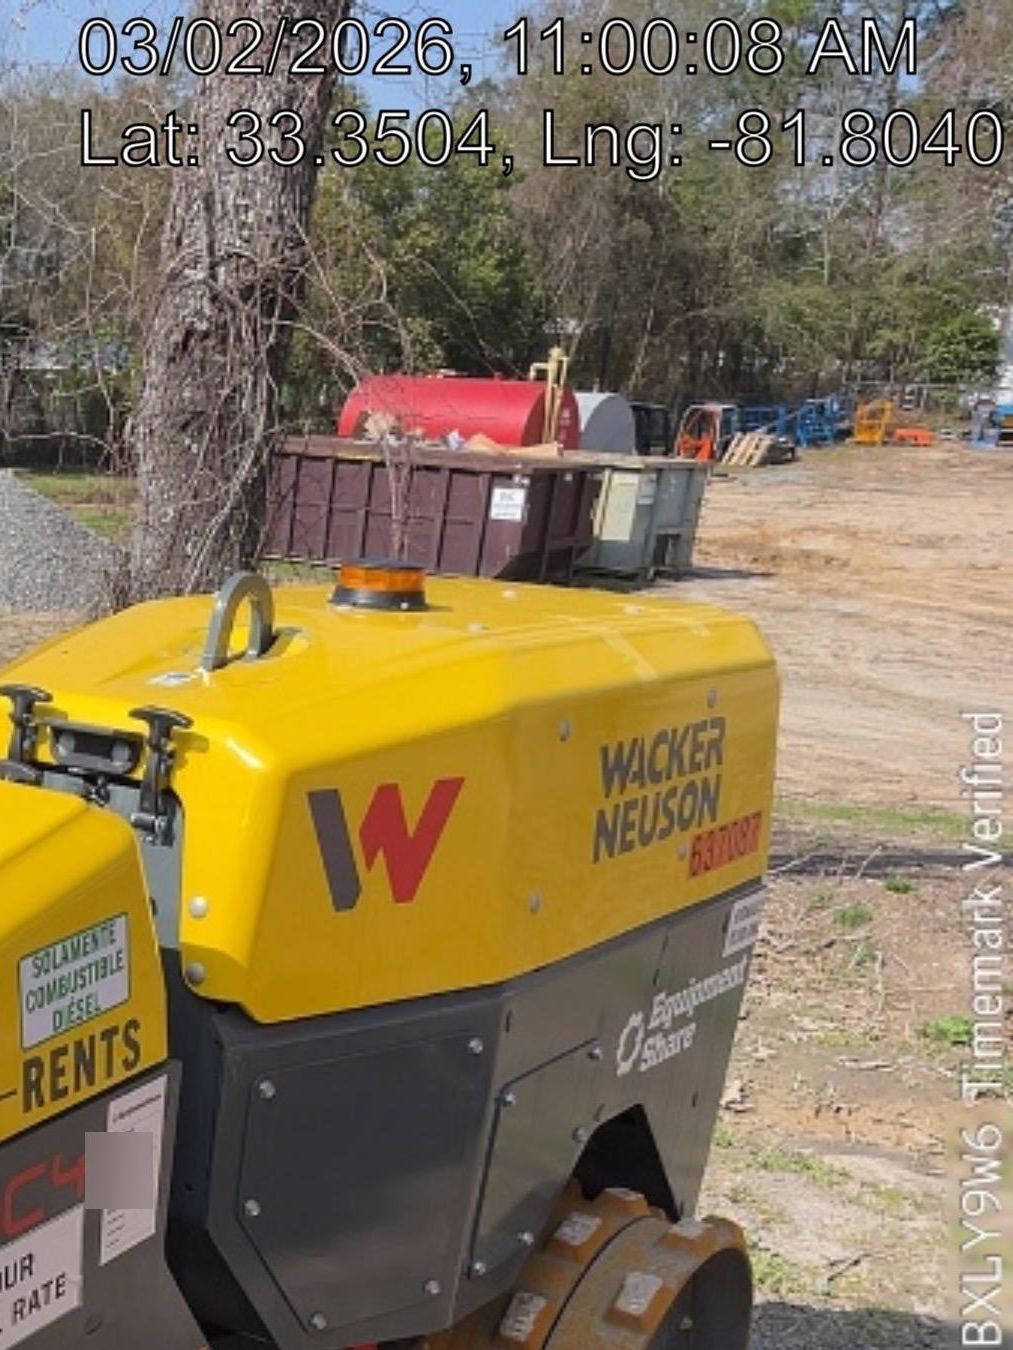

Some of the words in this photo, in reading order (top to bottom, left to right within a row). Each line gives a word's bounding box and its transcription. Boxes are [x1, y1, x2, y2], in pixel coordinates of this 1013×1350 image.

[600, 716, 726, 798] WACKER
[592, 773, 723, 865] NEUSON
[25, 950, 124, 1014] COMBUSTIBLE
[32, 921, 117, 979] SOLAMENTE
[648, 954, 747, 1031] Equipment
[640, 1021, 696, 1072] Share
[10, 1272, 67, 1328] RATE
